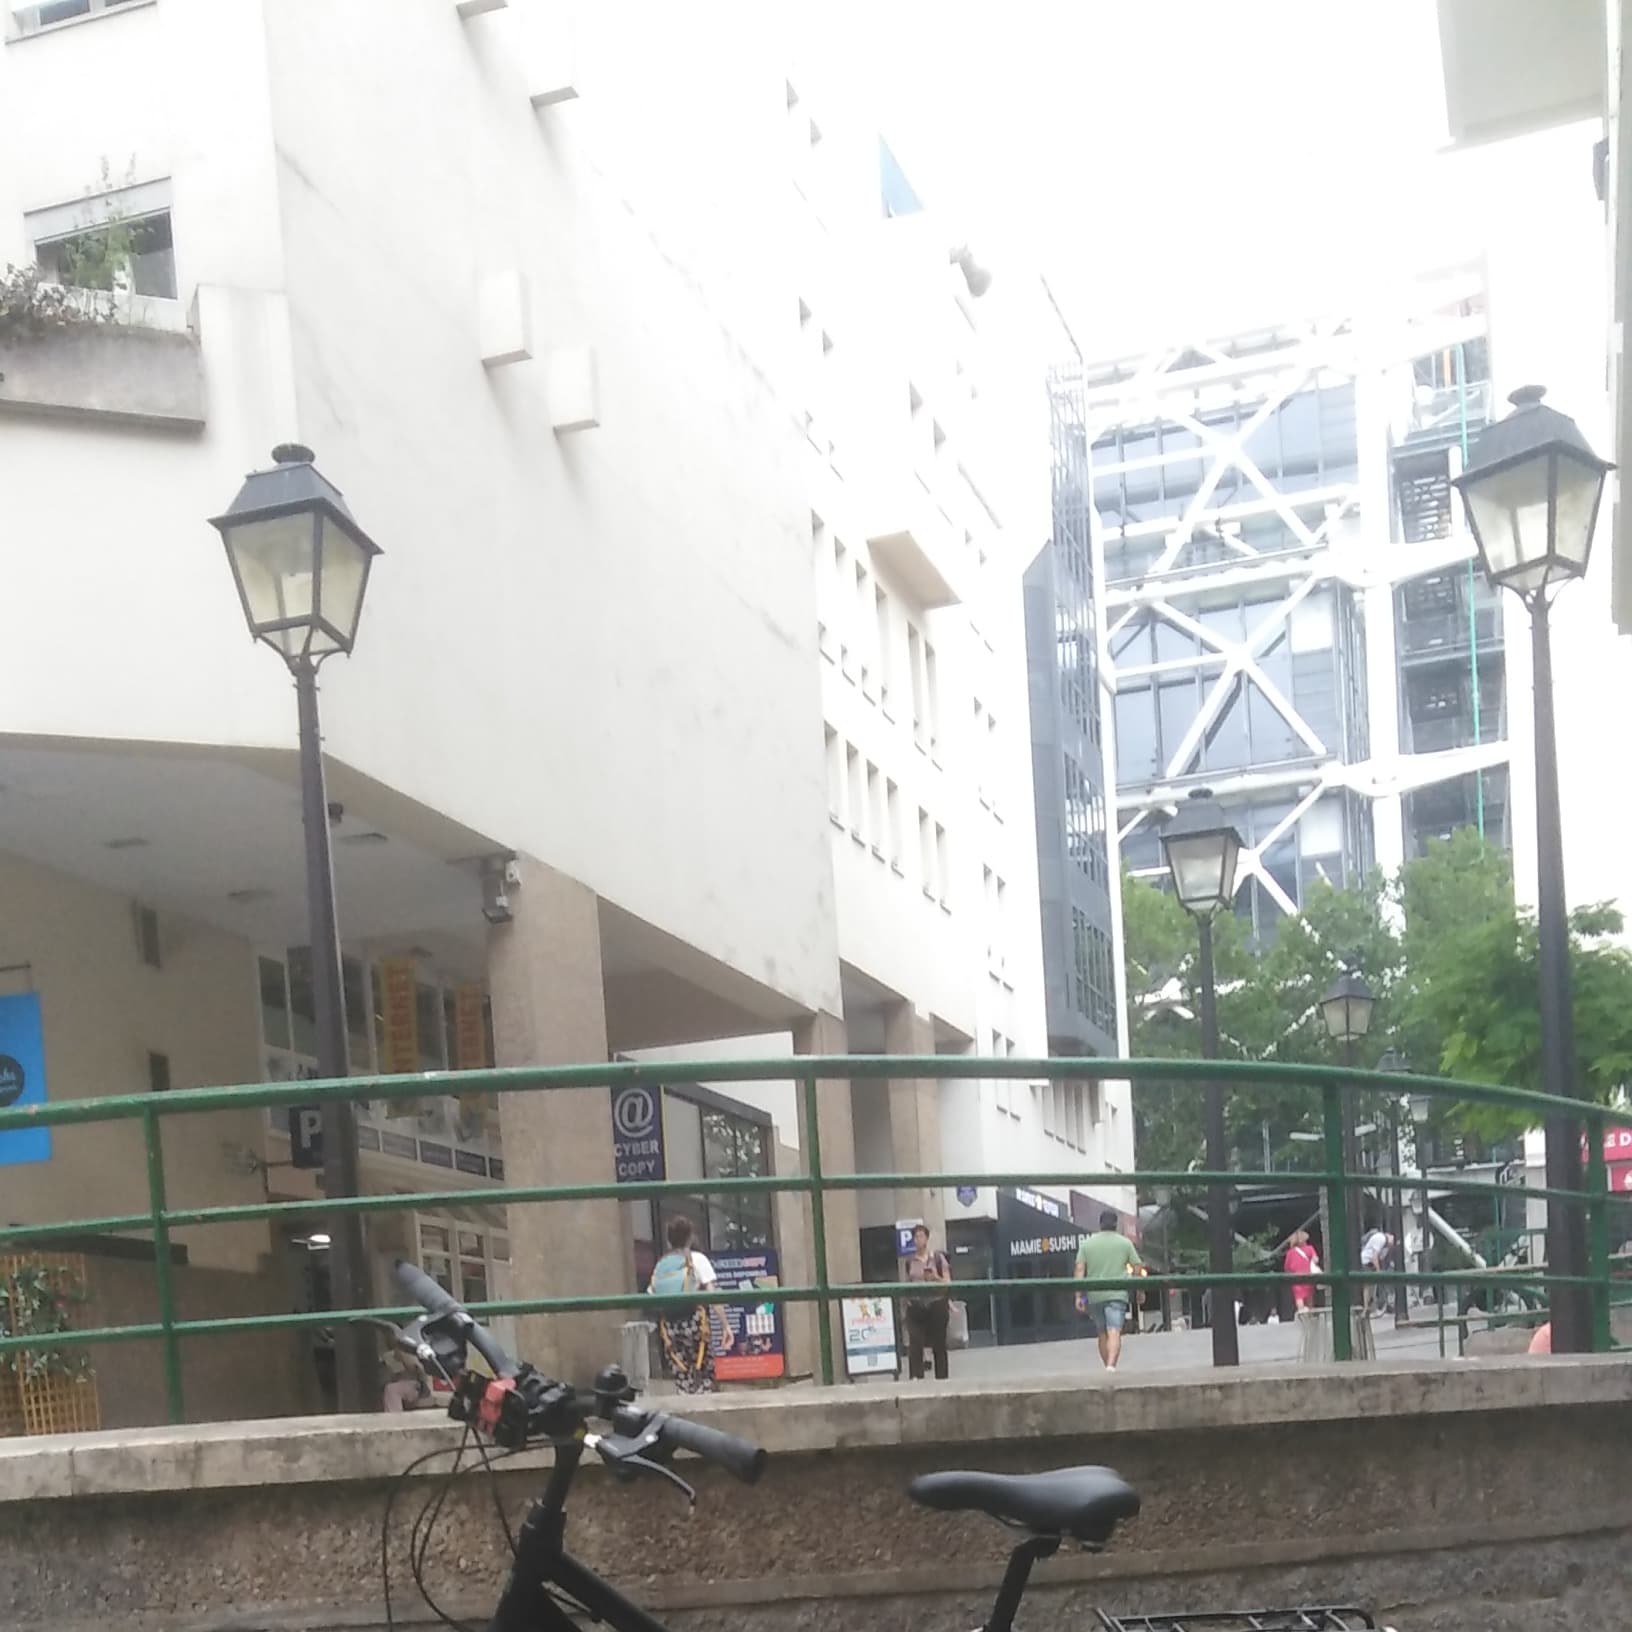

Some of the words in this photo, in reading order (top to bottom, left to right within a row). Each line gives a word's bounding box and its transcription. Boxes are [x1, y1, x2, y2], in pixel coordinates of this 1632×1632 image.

[386, 964, 413, 1074] NTERNET
[615, 1140, 660, 1158] CYBER
[618, 1160, 656, 1177] COPY
[900, 1229, 913, 1249] P
[1010, 1237, 1043, 1257] MAMIE
[1048, 1234, 1077, 1252] SUSHI
